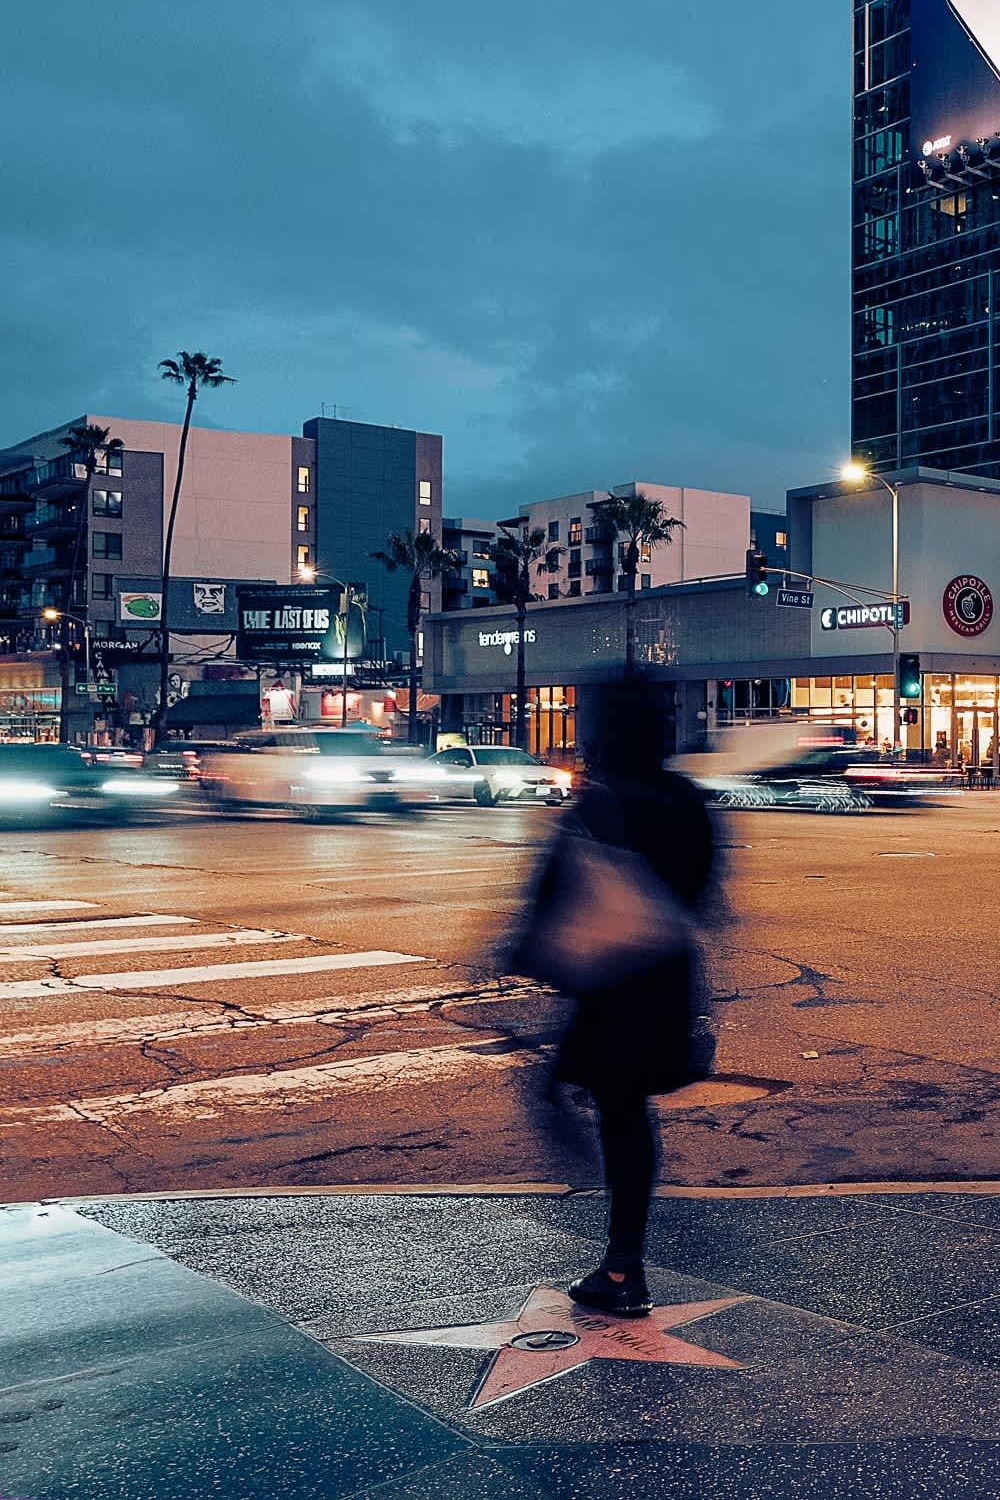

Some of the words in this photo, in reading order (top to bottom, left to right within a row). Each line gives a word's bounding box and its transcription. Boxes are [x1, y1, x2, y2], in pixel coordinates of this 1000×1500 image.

[782, 593, 799, 603] Vine
[801, 595, 810, 605] St
[948, 577, 991, 602] CHIPOTLE
[243, 610, 271, 629] THE
[274, 610, 302, 629] LAST
[303, 609, 313, 629] OF
[314, 609, 330, 629] US
[838, 606, 896, 625] CHIPOTL
[950, 610, 975, 632] MEXICAN
[975, 612, 990, 631] GRILL
[93, 641, 138, 649] MORGAN
[538, 1304, 609, 1331] EDWARD
[601, 1330, 666, 1356] SMALL
